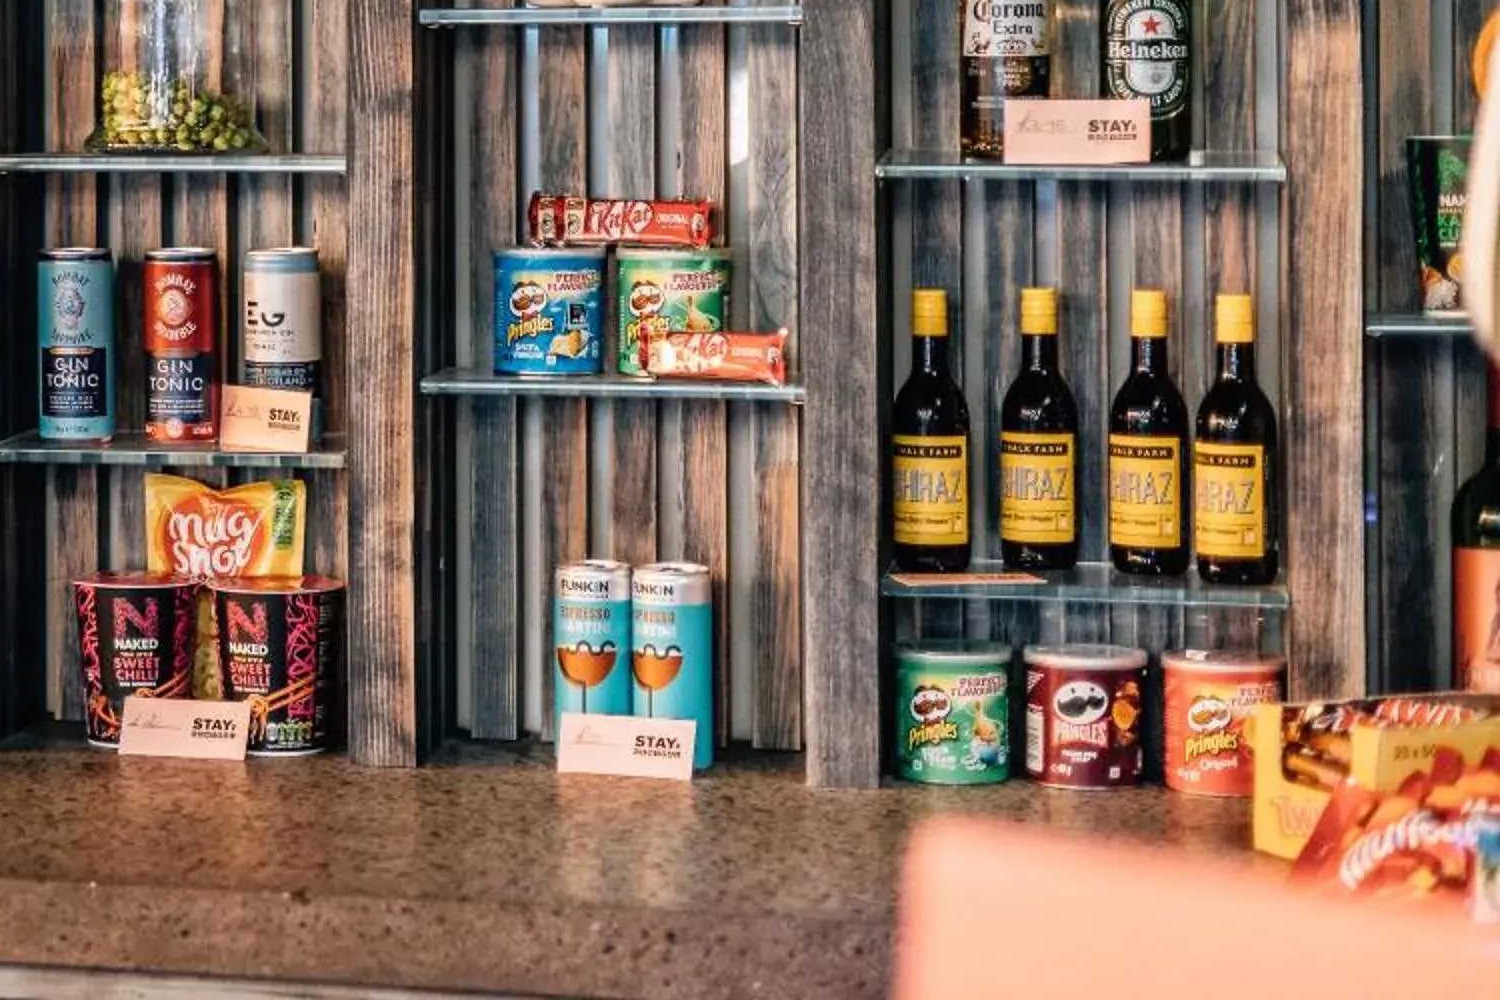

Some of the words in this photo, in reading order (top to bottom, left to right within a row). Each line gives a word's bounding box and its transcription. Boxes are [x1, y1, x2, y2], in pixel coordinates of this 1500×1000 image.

[973, 0, 1046, 24] Corona
[993, 20, 1033, 35] Extra
[507, 314, 555, 347] Pringles
[55, 356, 90, 371] GIN
[157, 359, 193, 373] GIN
[46, 373, 99, 388] TONIC
[150, 377, 204, 391] TONIC
[895, 468, 963, 503] HIRAZ
[1111, 470, 1173, 505] HIRAZ
[114, 638, 159, 650] NAKED
[229, 642, 269, 656] NAKED
[114, 657, 160, 669] SWEET
[229, 661, 271, 674] SWEET
[115, 669, 160, 681] CHILLI
[231, 674, 271, 687] CHILLI
[907, 720, 959, 749] Pringles
[1054, 720, 1108, 748] PRINGLES
[1185, 728, 1238, 760] Pringles
